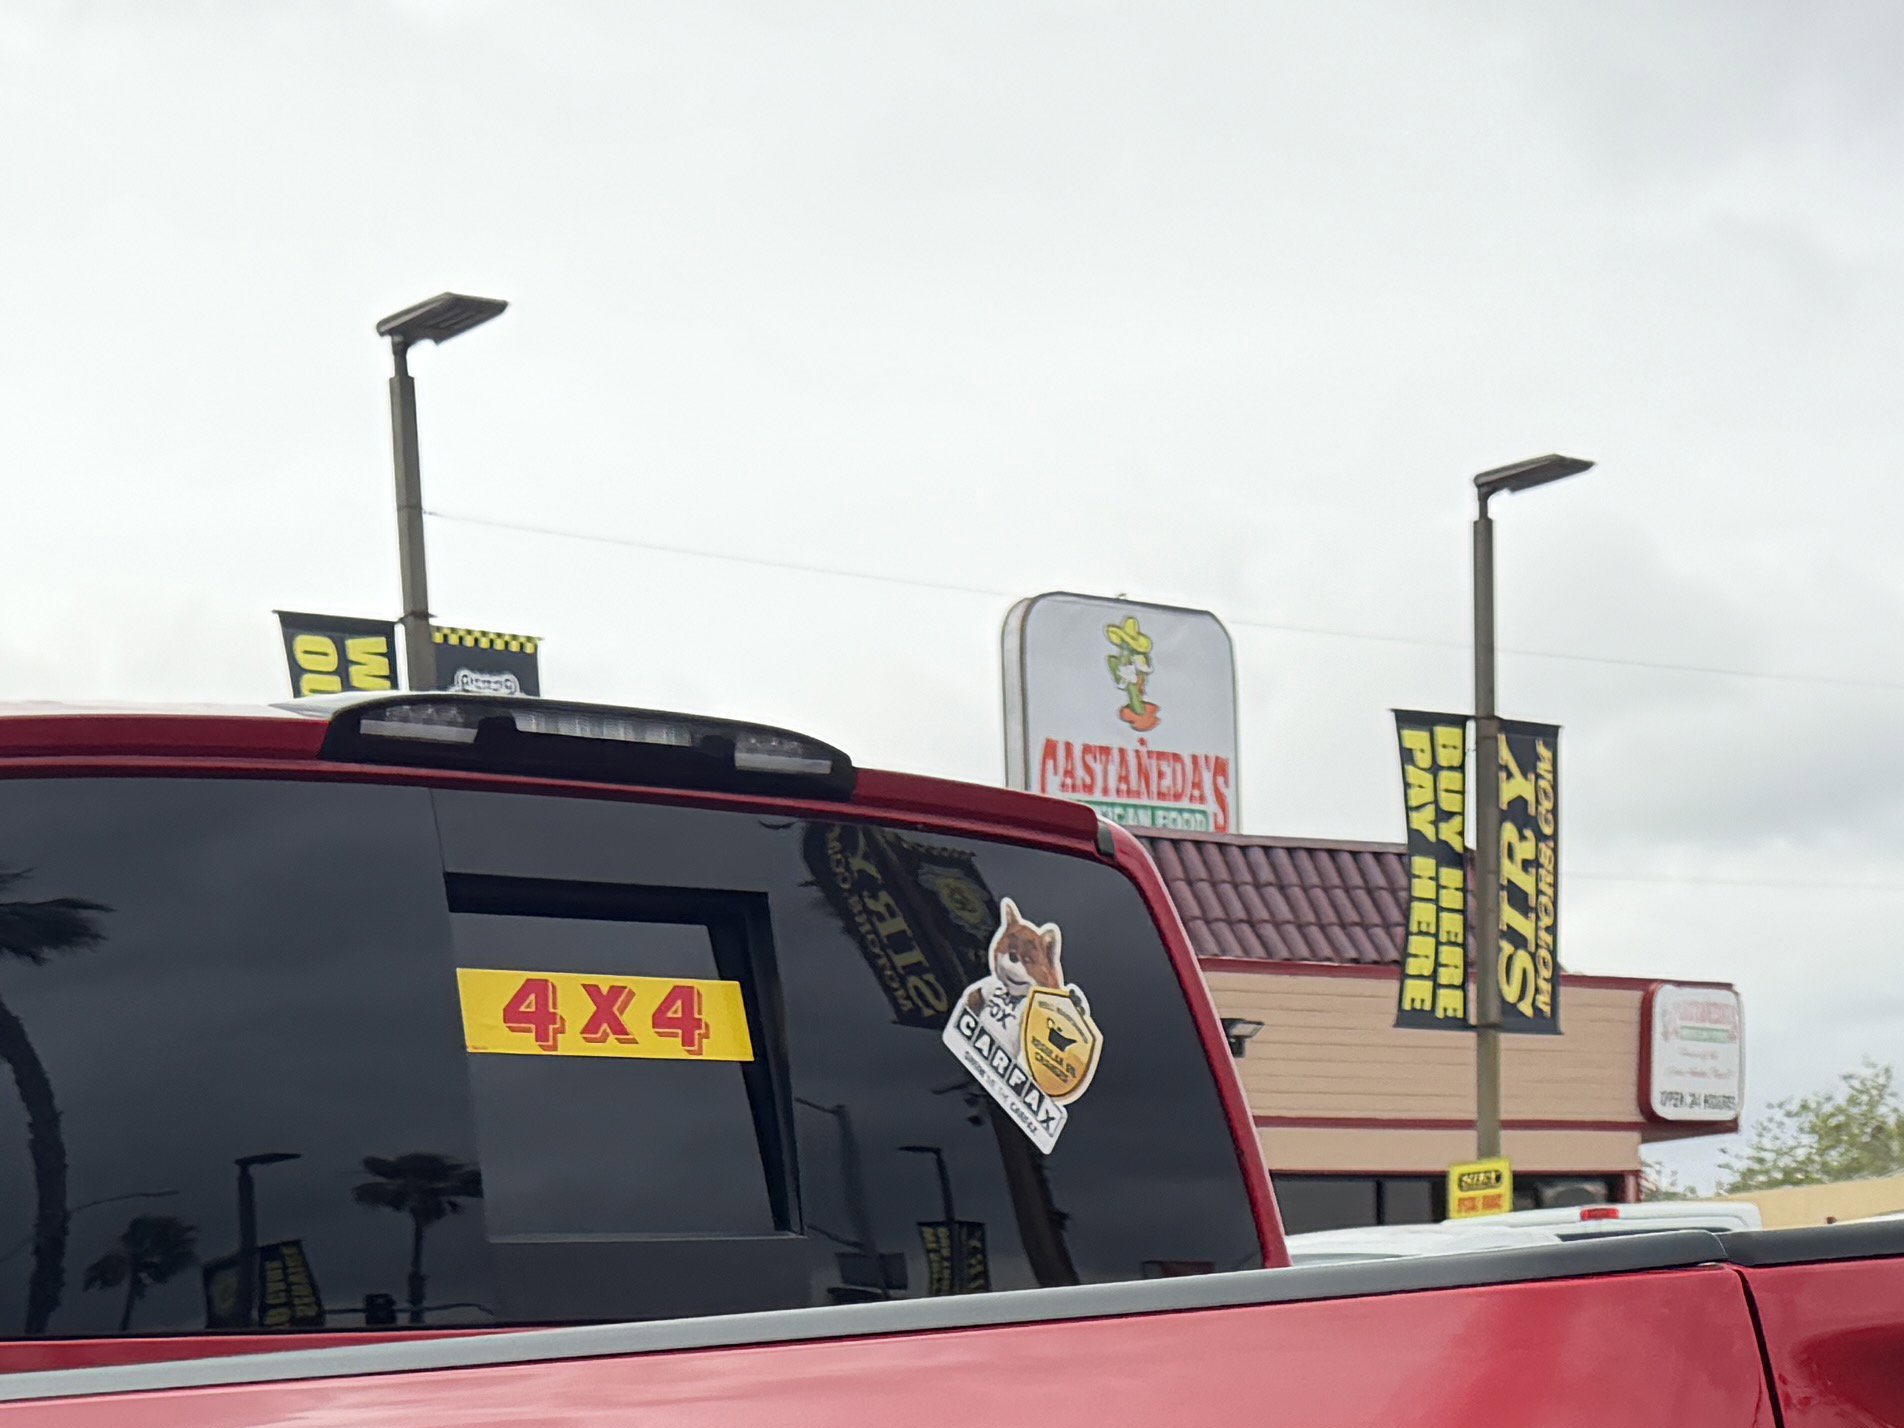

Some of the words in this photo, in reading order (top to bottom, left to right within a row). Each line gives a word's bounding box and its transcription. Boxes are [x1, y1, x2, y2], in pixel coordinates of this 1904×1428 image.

[1400, 729, 1436, 843] PAY
[1433, 725, 1463, 854] BUY
[1401, 856, 1437, 1011] HERE
[1435, 867, 1464, 1019] HERE
[1497, 733, 1536, 1018] SIRY
[1535, 738, 1555, 1018] MOTORS.COM
[957, 1008, 1057, 1134] CARFAX
